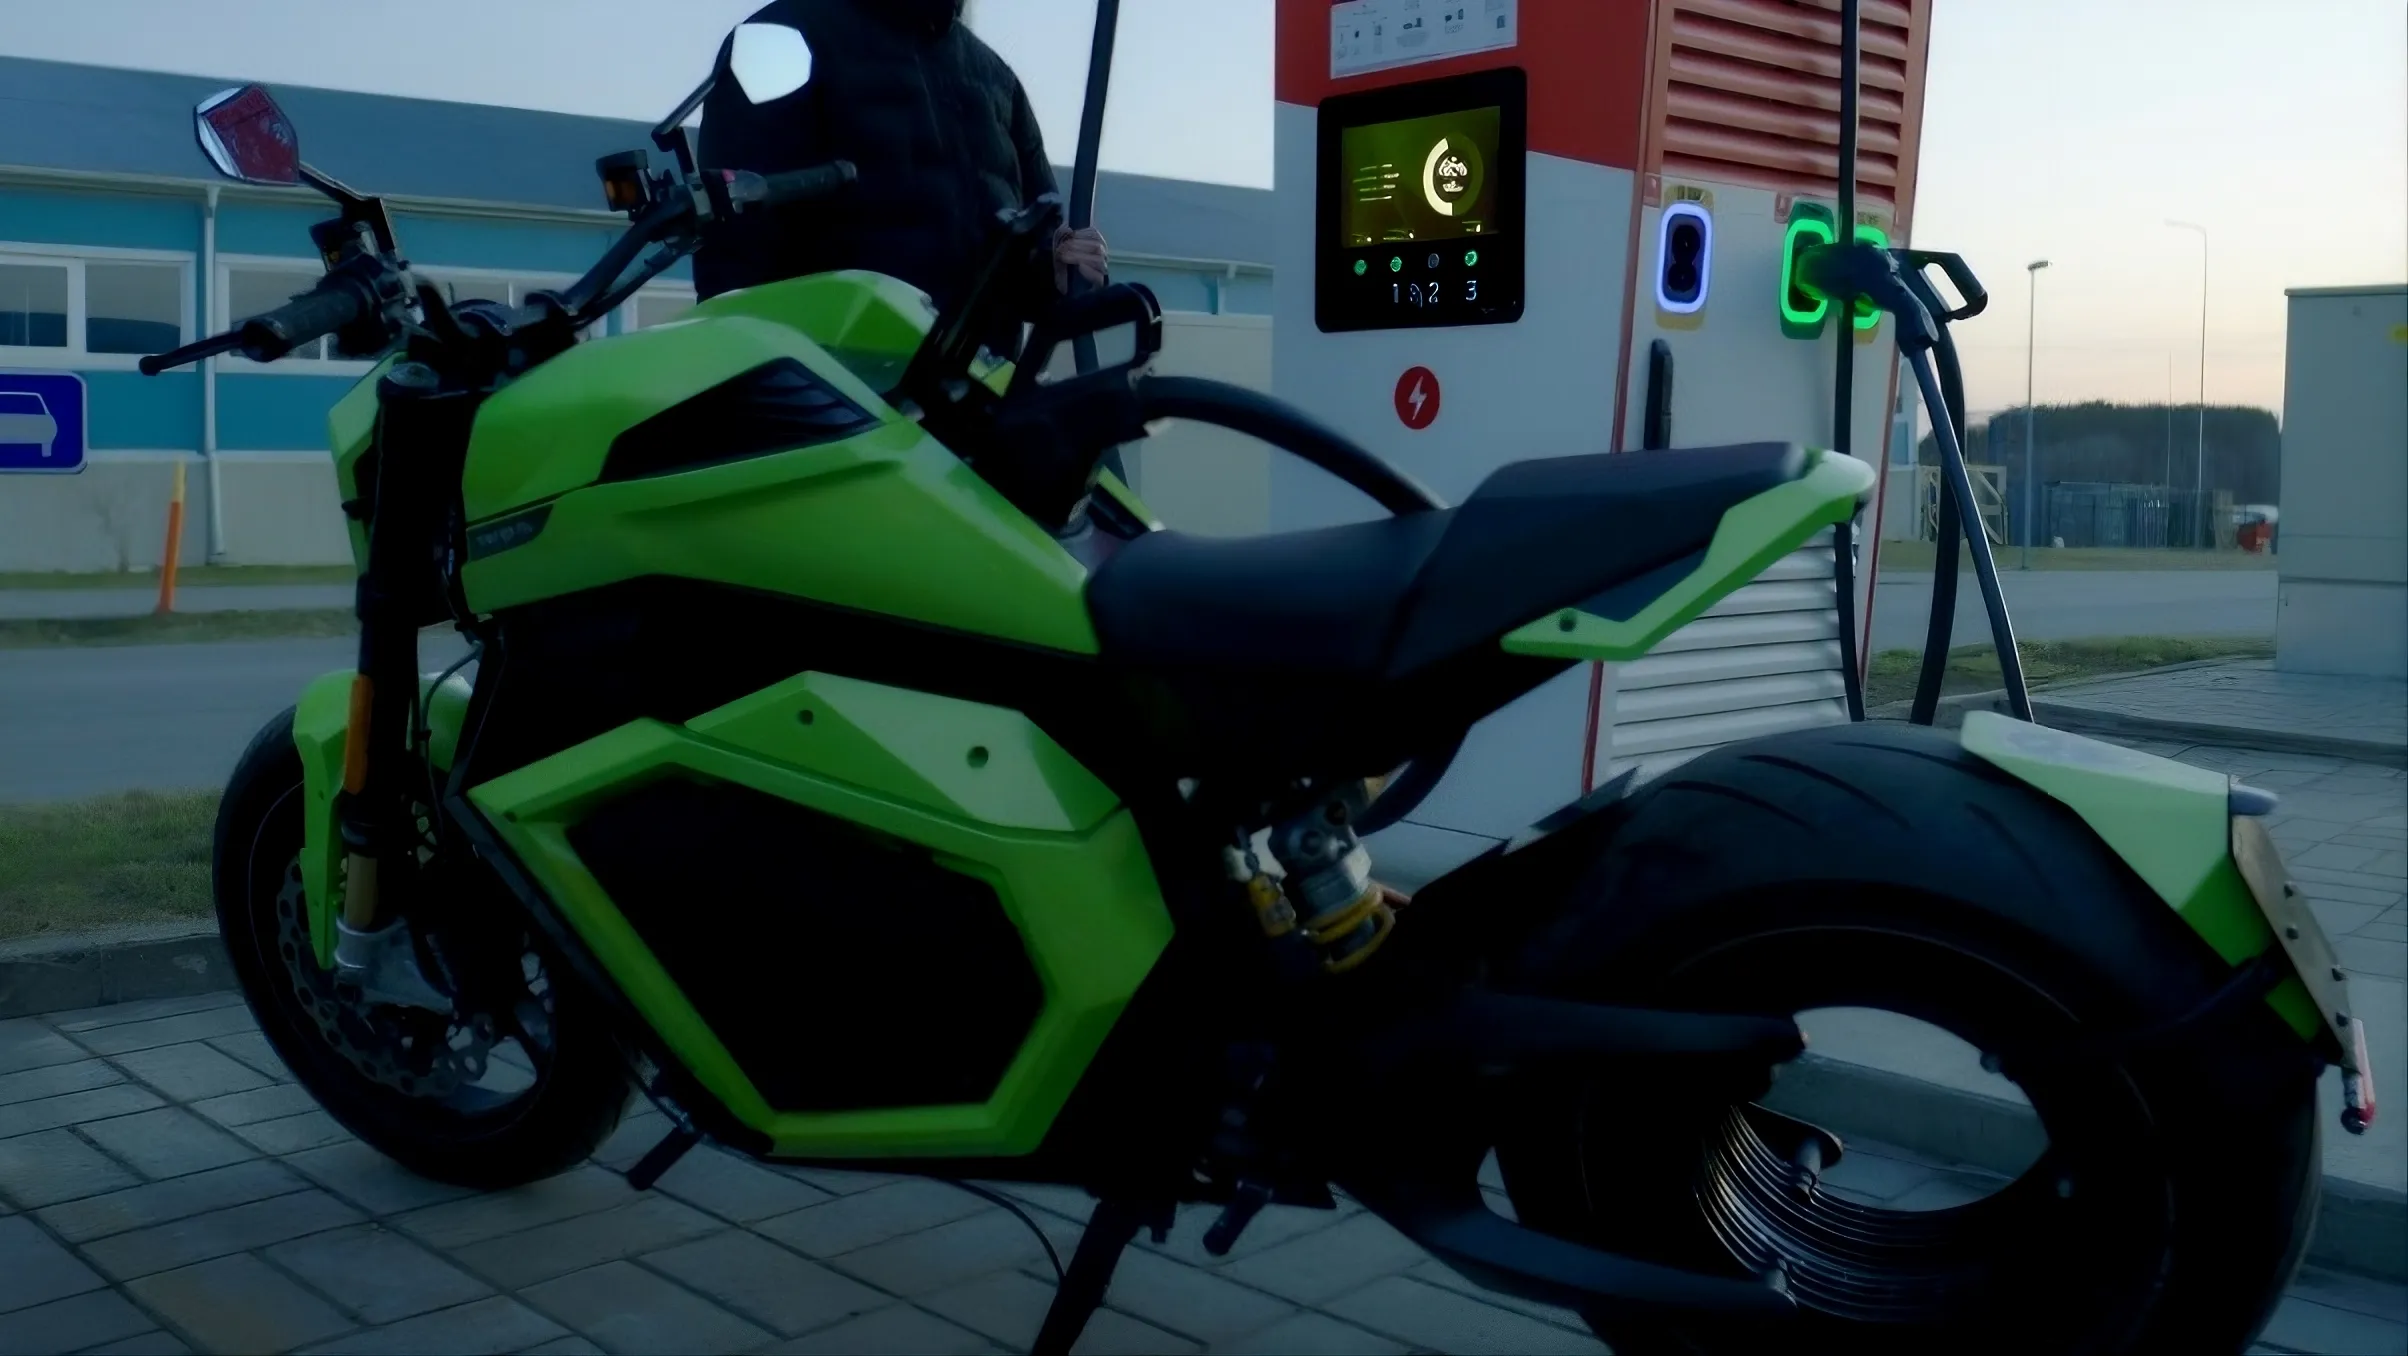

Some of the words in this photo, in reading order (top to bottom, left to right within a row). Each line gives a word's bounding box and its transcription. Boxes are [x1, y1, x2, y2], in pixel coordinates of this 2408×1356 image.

[1392, 283, 1399, 304] 1
[1428, 281, 1439, 303] 2
[1465, 280, 1477, 301] 3
